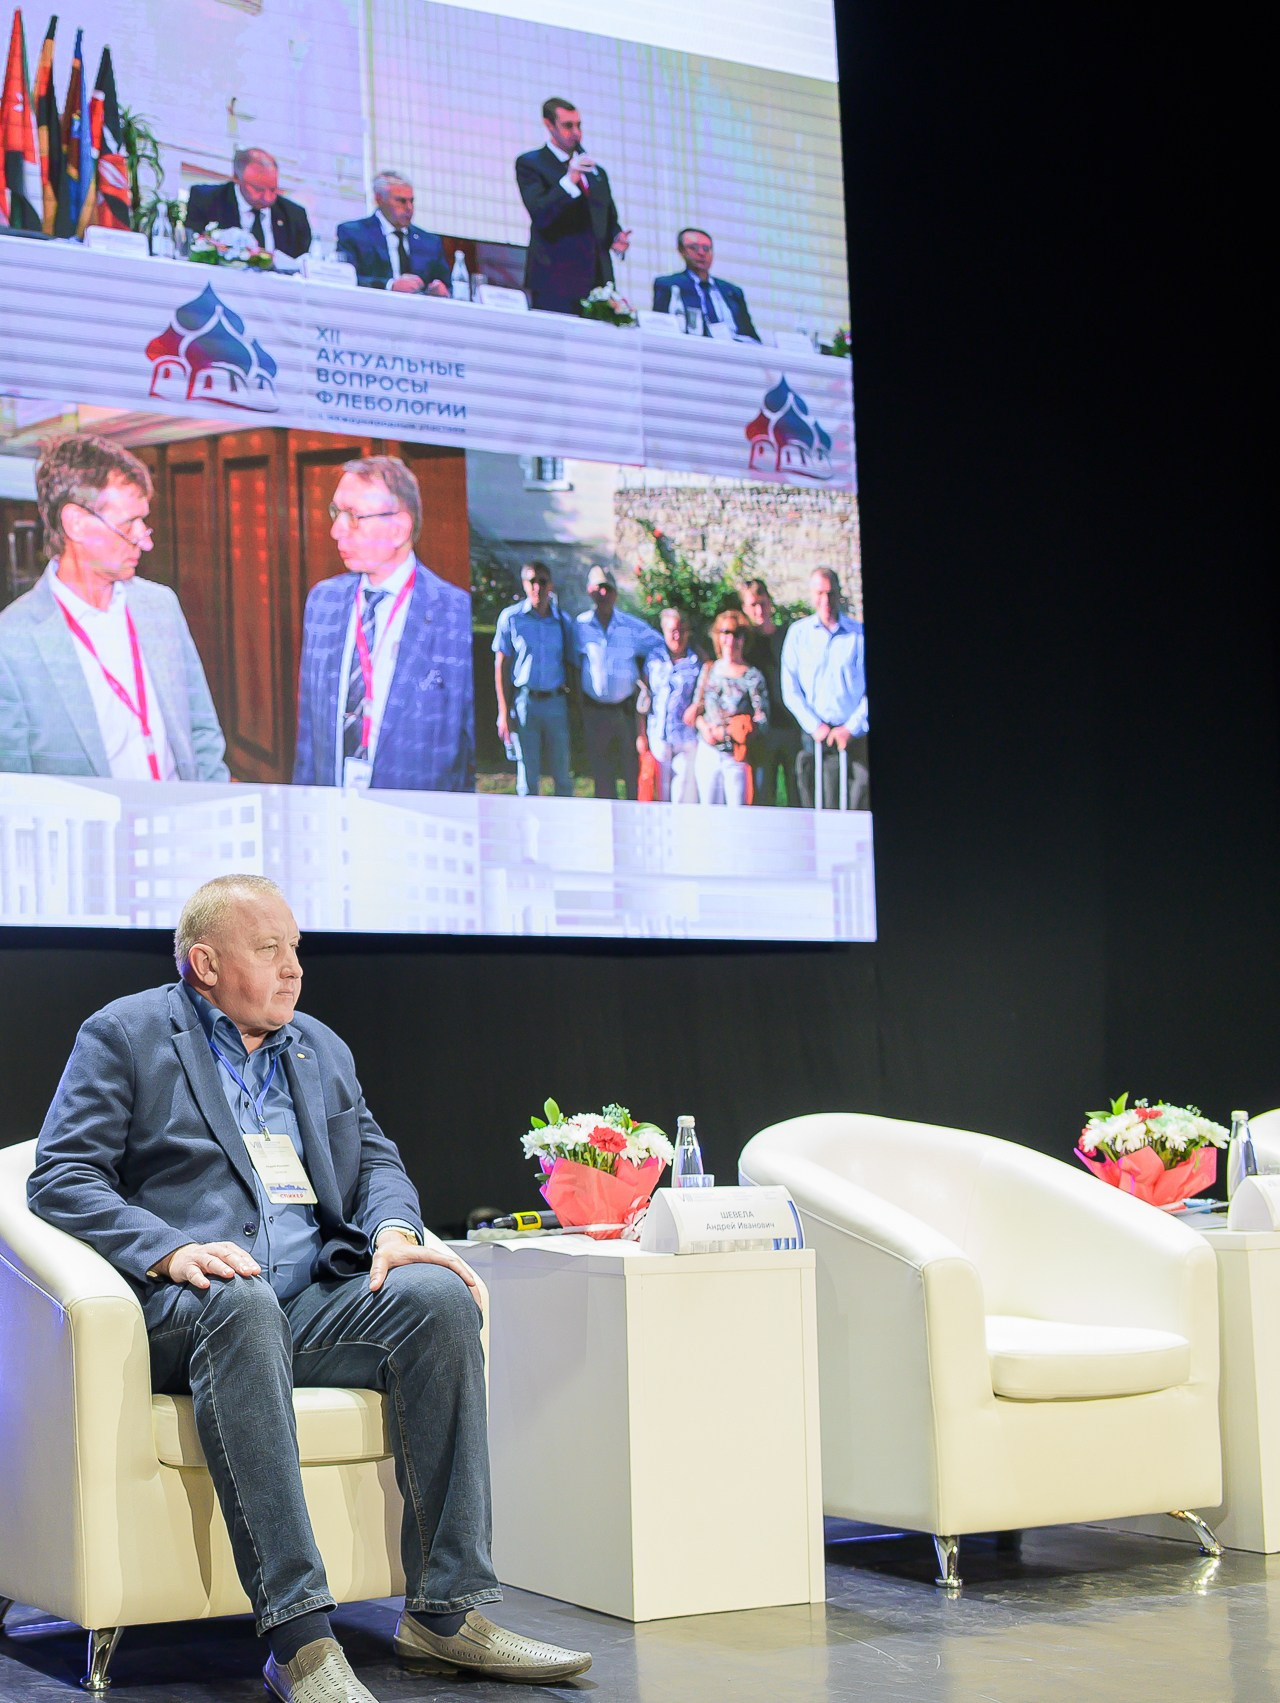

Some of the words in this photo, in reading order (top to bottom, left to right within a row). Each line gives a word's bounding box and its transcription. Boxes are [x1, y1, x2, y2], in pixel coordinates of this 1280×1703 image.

[316, 326, 340, 344] XII
[316, 347, 466, 378] АКТУАЛЬНЫЕ
[316, 367, 429, 394] ВОПРОСЫ
[316, 390, 467, 419] ФЛЕБОЛОГИИ
[720, 1210, 755, 1219] ШЕВЕЛА
[706, 1222, 736, 1232] Андрей
[737, 1222, 775, 1230] Иванович
